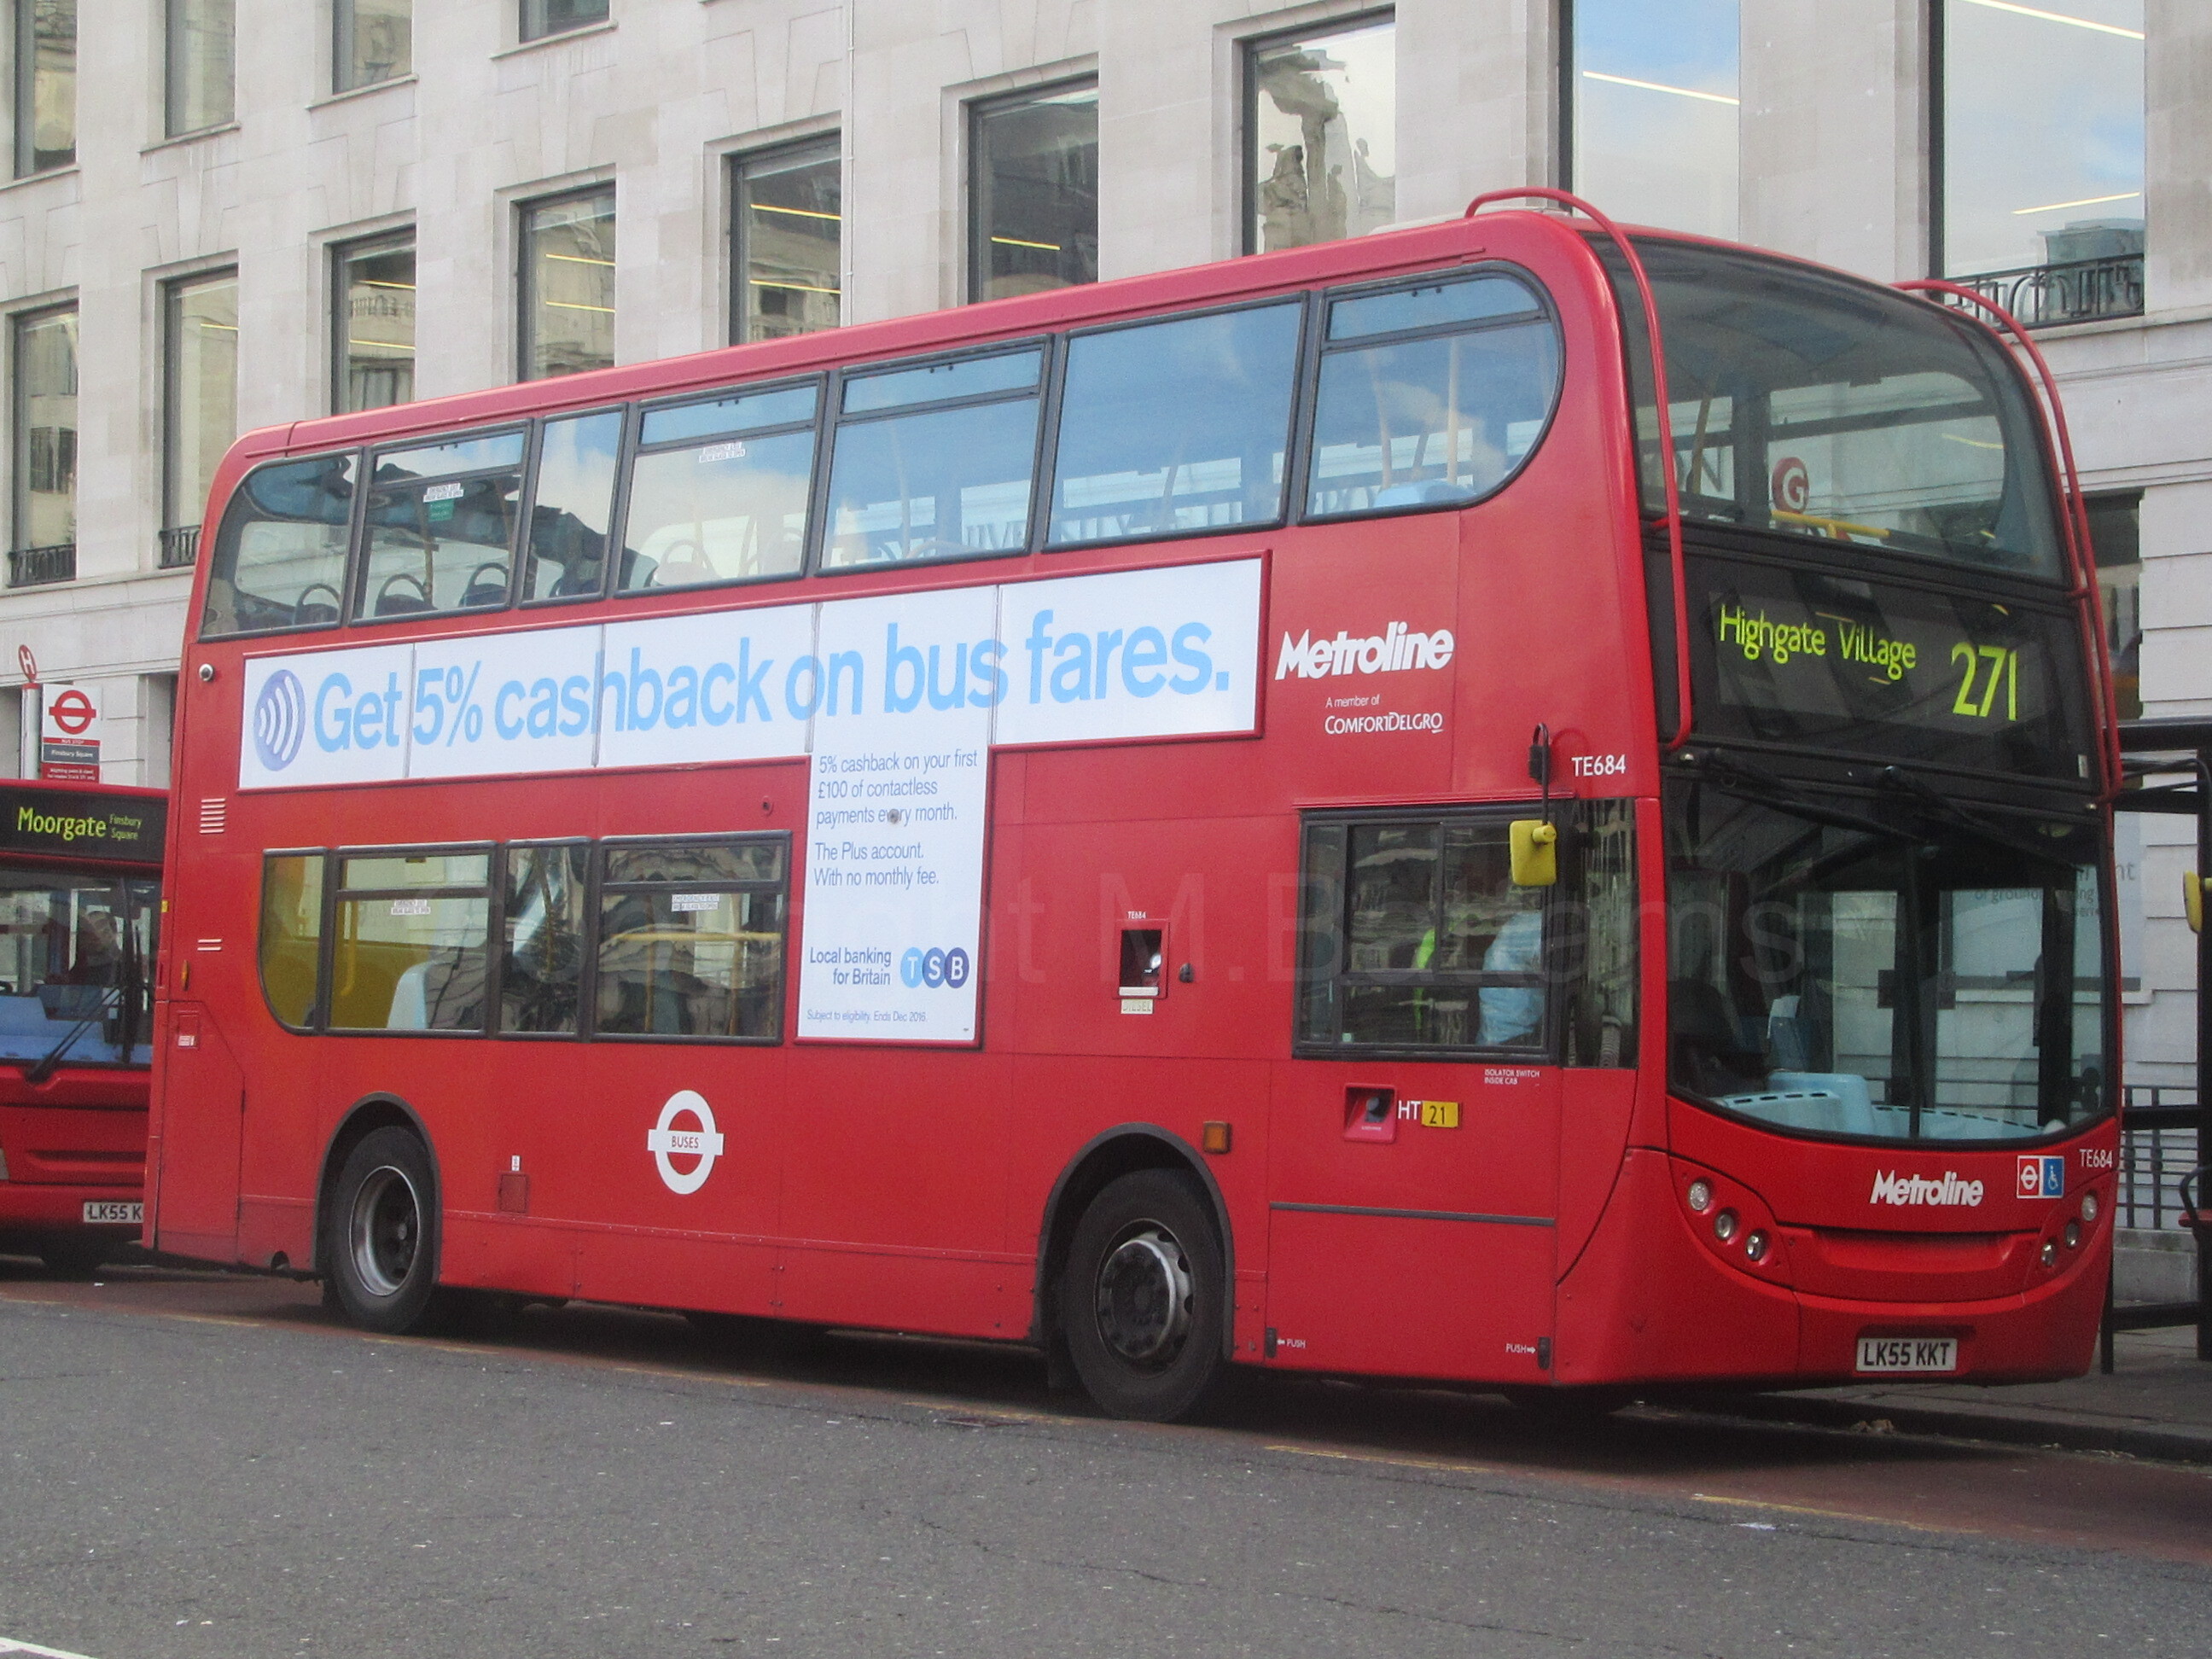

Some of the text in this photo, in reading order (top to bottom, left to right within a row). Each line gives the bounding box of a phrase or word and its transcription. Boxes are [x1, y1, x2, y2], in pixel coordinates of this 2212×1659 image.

[1274, 620, 1455, 680] Metroline
[1720, 603, 1917, 680] Highgate Village
[313, 609, 1230, 754] Get 5% cashback on bus fares.
[1950, 642, 2017, 721] 271
[1325, 694, 1381, 707] A member of
[819, 748, 978, 775] 5% cashback on your first
[1571, 754, 1627, 777] TE684
[818, 777, 938, 799] £100 of contactless
[17, 806, 107, 841] Moorgate
[816, 801, 958, 830] payments evry month.
[815, 841, 924, 861] The Plus account.
[814, 866, 940, 891] With no monthly fee.
[810, 946, 892, 967] Local banking
[833, 968, 891, 986] for Britain
[904, 953, 966, 983] TSB
[806, 1009, 832, 1022] Subject
[833, 1011, 841, 1020] to
[874, 1010, 891, 1022] Ends
[893, 1011, 907, 1022] Dec
[1397, 1100, 1421, 1120] HT
[1430, 1106, 1447, 1125] 21
[672, 1136, 699, 1149] BUSES
[2079, 1149, 2112, 1168] TE684
[1869, 1169, 1984, 1208] Metroline
[87, 1205, 128, 1220] LK55
[1286, 1339, 1306, 1348] PUSH
[1505, 1343, 1528, 1353] PUSH
[1863, 1342, 1951, 1366] LK55 KKT
